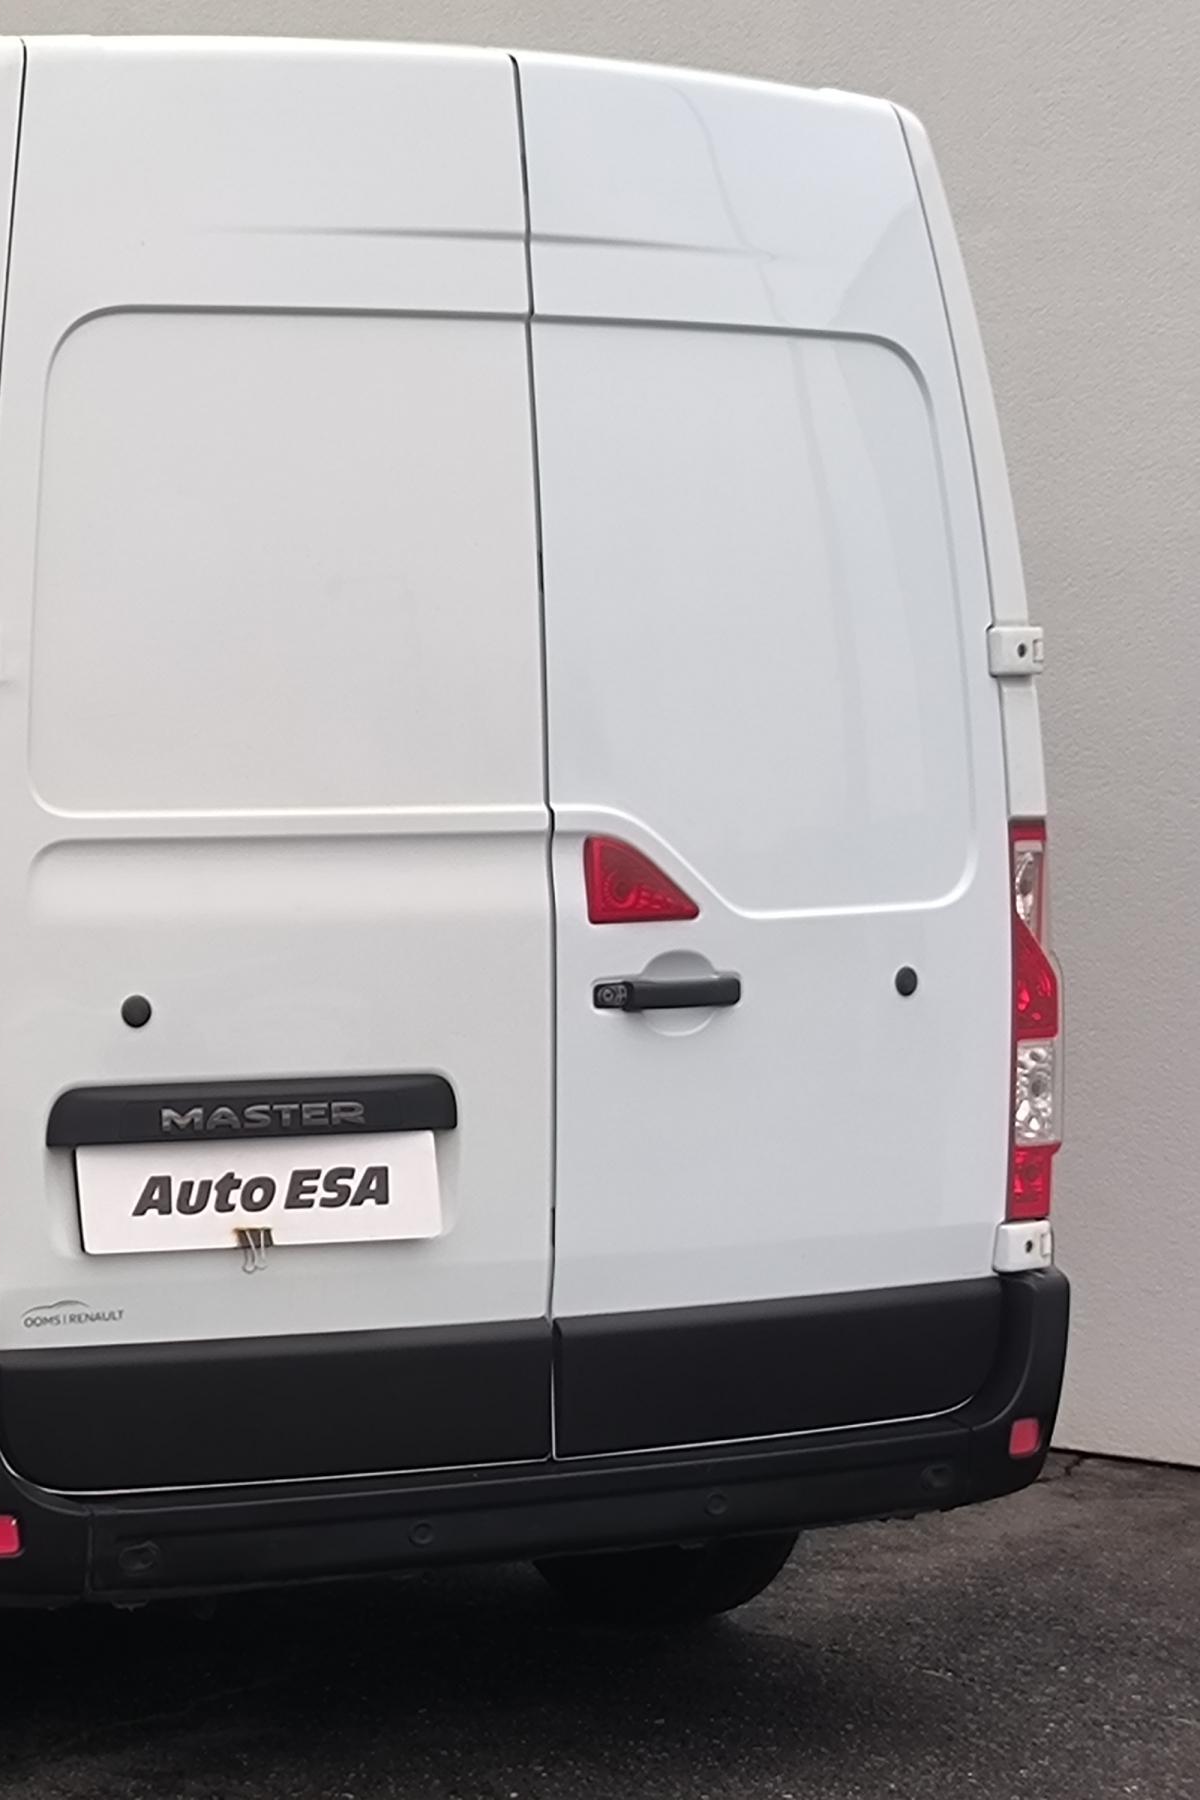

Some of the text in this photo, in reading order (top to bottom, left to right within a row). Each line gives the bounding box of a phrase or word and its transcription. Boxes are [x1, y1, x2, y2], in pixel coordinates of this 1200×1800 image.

[160, 1100, 366, 1132] MASTER
[132, 1165, 390, 1217] Auto ESA
